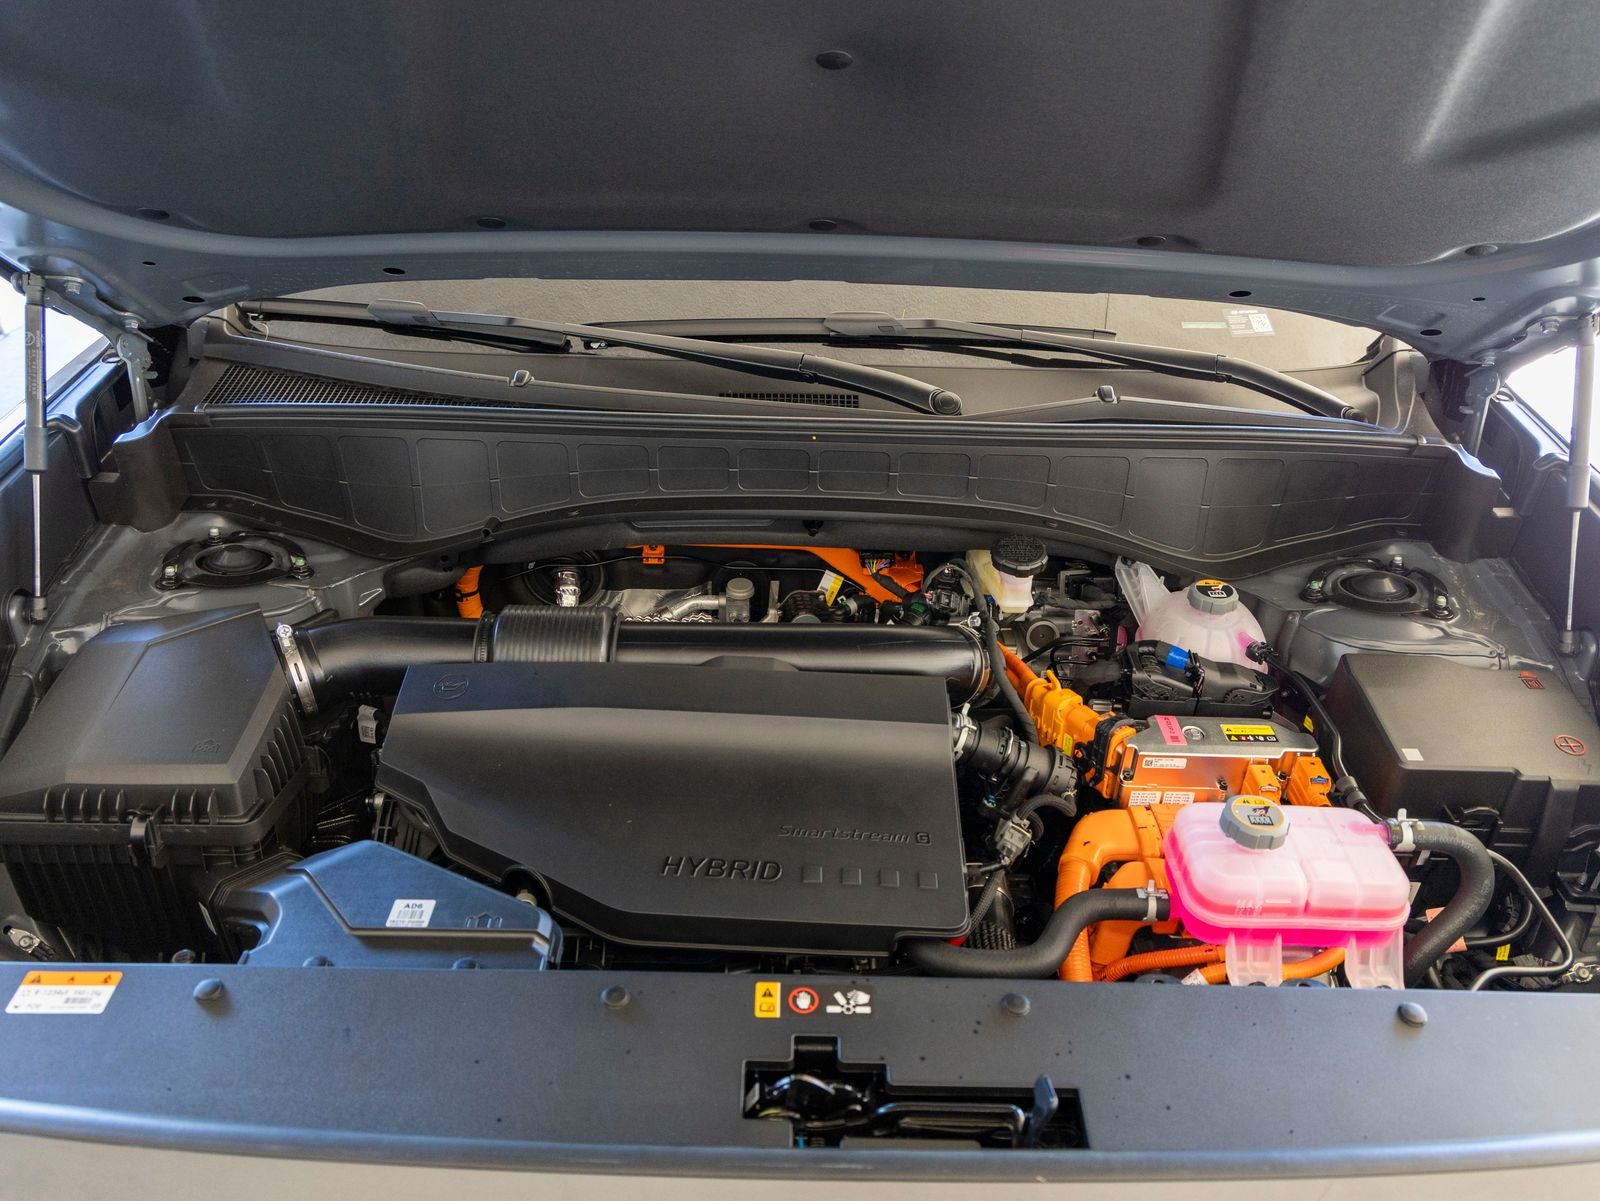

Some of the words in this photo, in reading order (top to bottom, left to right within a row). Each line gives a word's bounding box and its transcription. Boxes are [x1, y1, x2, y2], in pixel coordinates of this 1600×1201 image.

[776, 824, 911, 845] Smartstream
[914, 831, 933, 846] G
[660, 855, 784, 883] HYBRID
